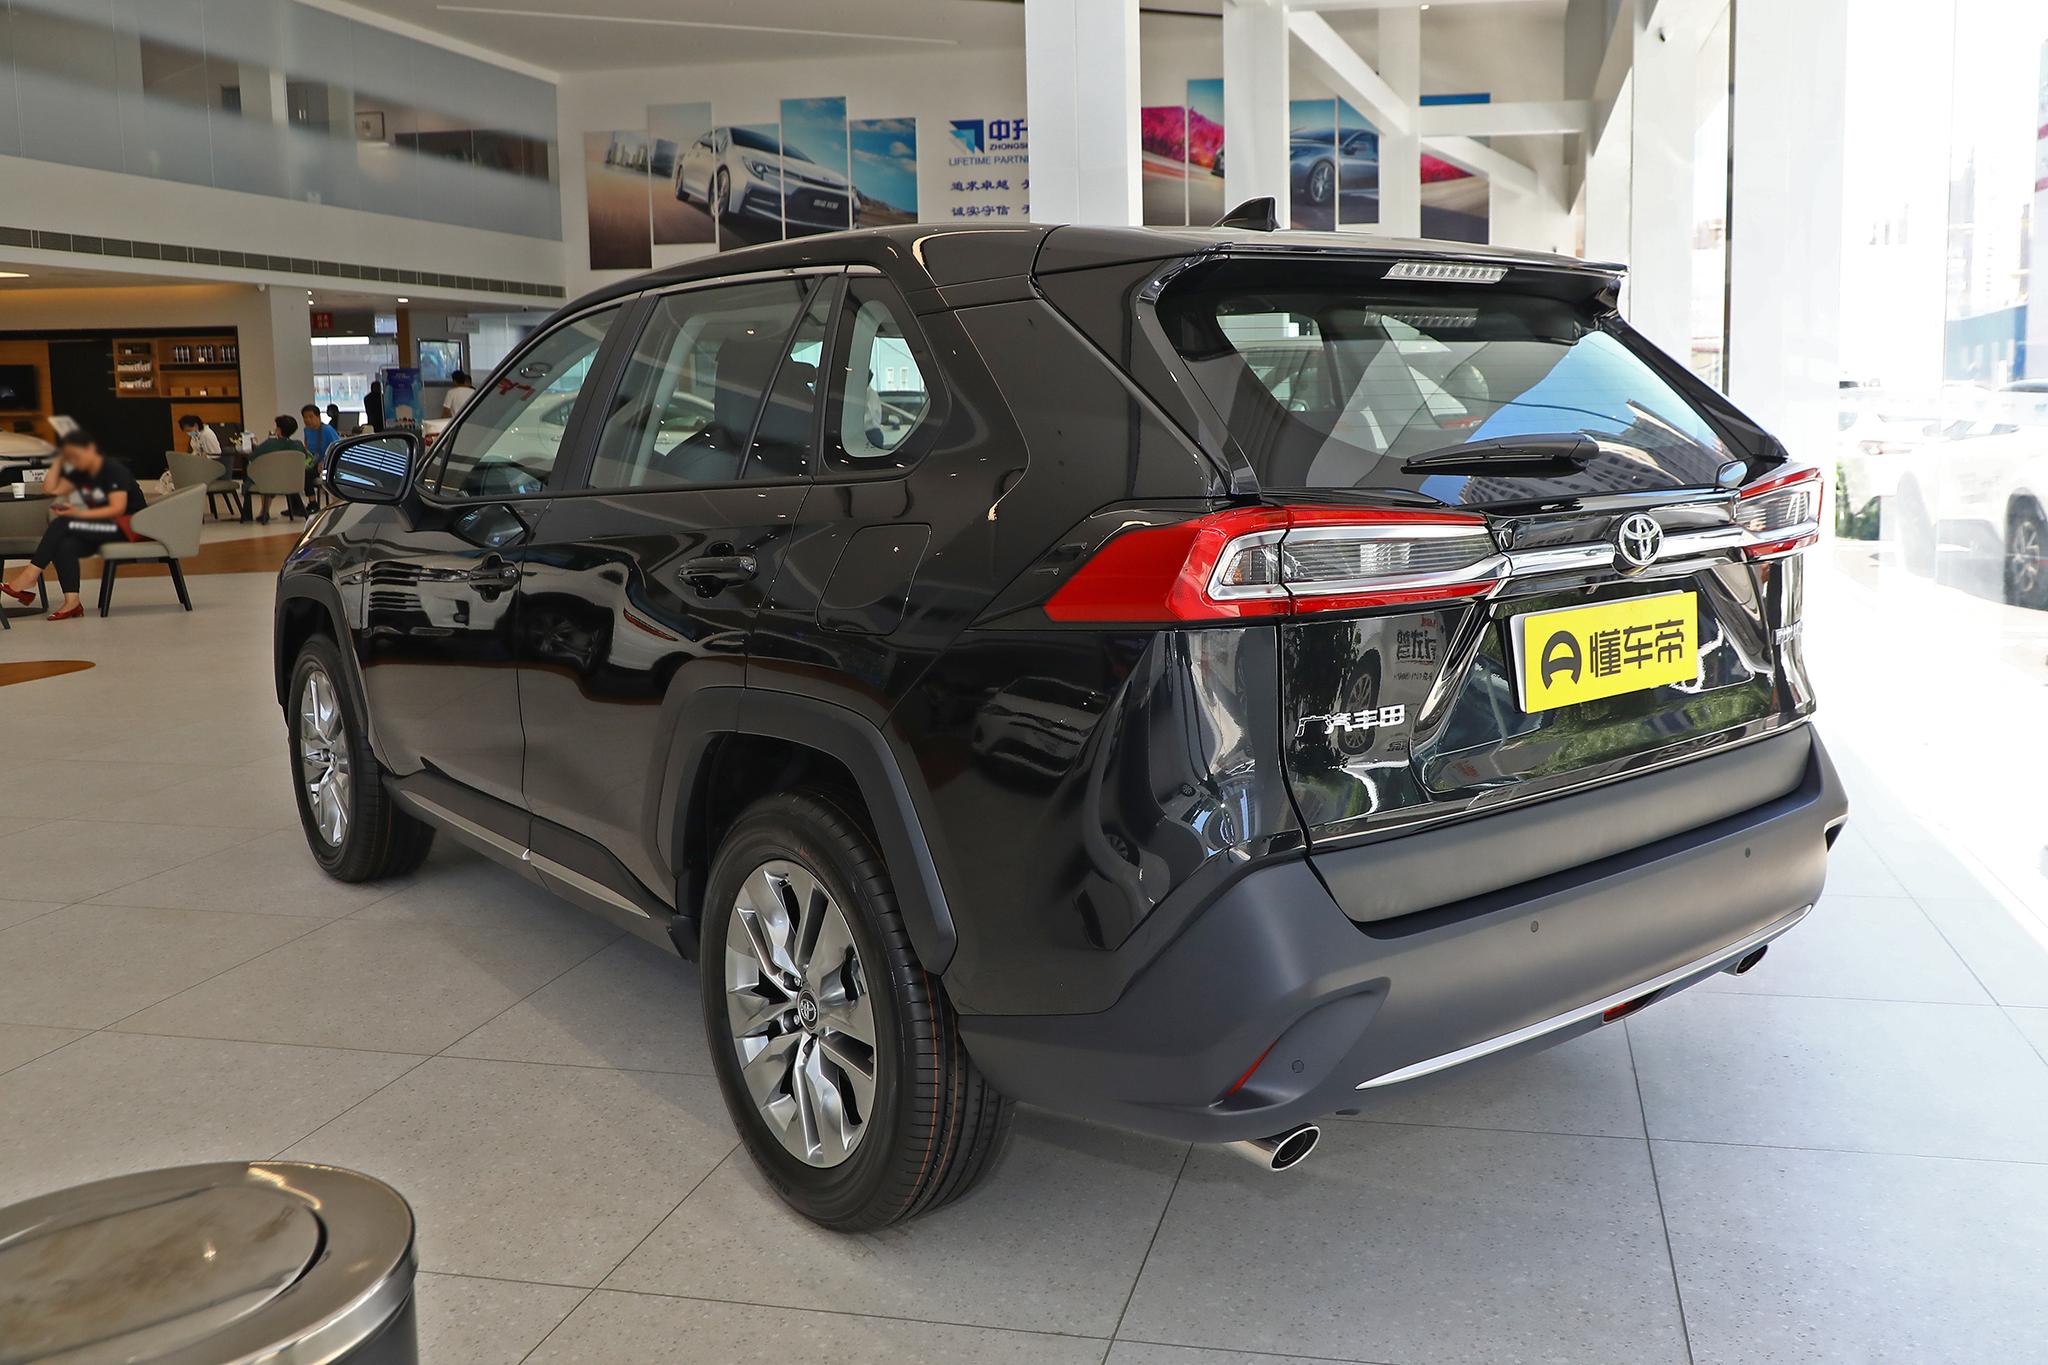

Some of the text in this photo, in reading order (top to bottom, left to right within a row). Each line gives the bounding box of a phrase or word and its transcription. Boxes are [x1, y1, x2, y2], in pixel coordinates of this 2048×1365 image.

[948, 155, 1029, 167] LIFETIME PARTN
[950, 179, 1010, 191] 追求卓越
[951, 205, 1011, 217] 诚实守信
[1589, 619, 1684, 678] 懂车帝
[1294, 704, 1405, 738] 广汽丰田
